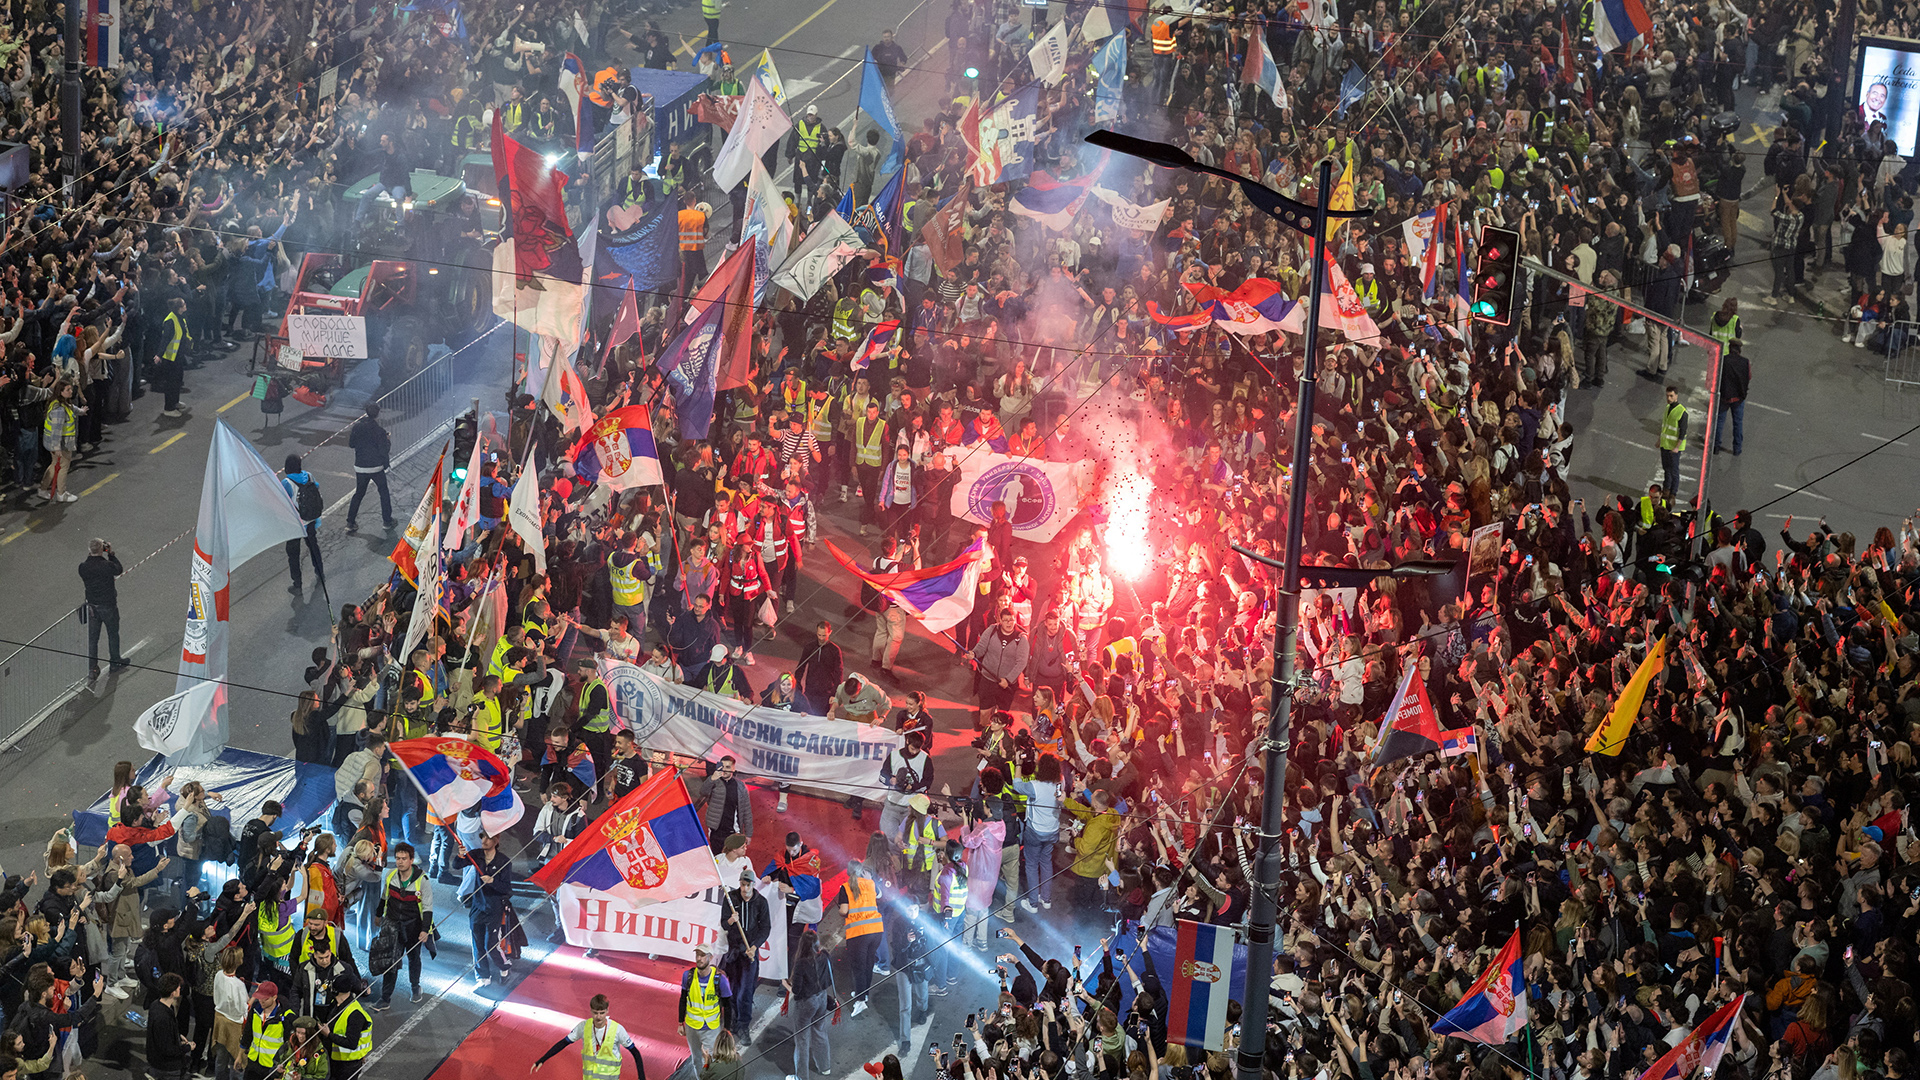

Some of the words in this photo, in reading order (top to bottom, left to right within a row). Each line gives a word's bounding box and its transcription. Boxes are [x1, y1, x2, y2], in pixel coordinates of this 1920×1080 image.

[293, 317, 356, 331] СЛОБОДА
[301, 330, 351, 343] МИРИШЕ
[300, 343, 317, 356] НА
[786, 730, 897, 761] ФАКУЛТЕТ
[752, 748, 800, 777] НИШ
